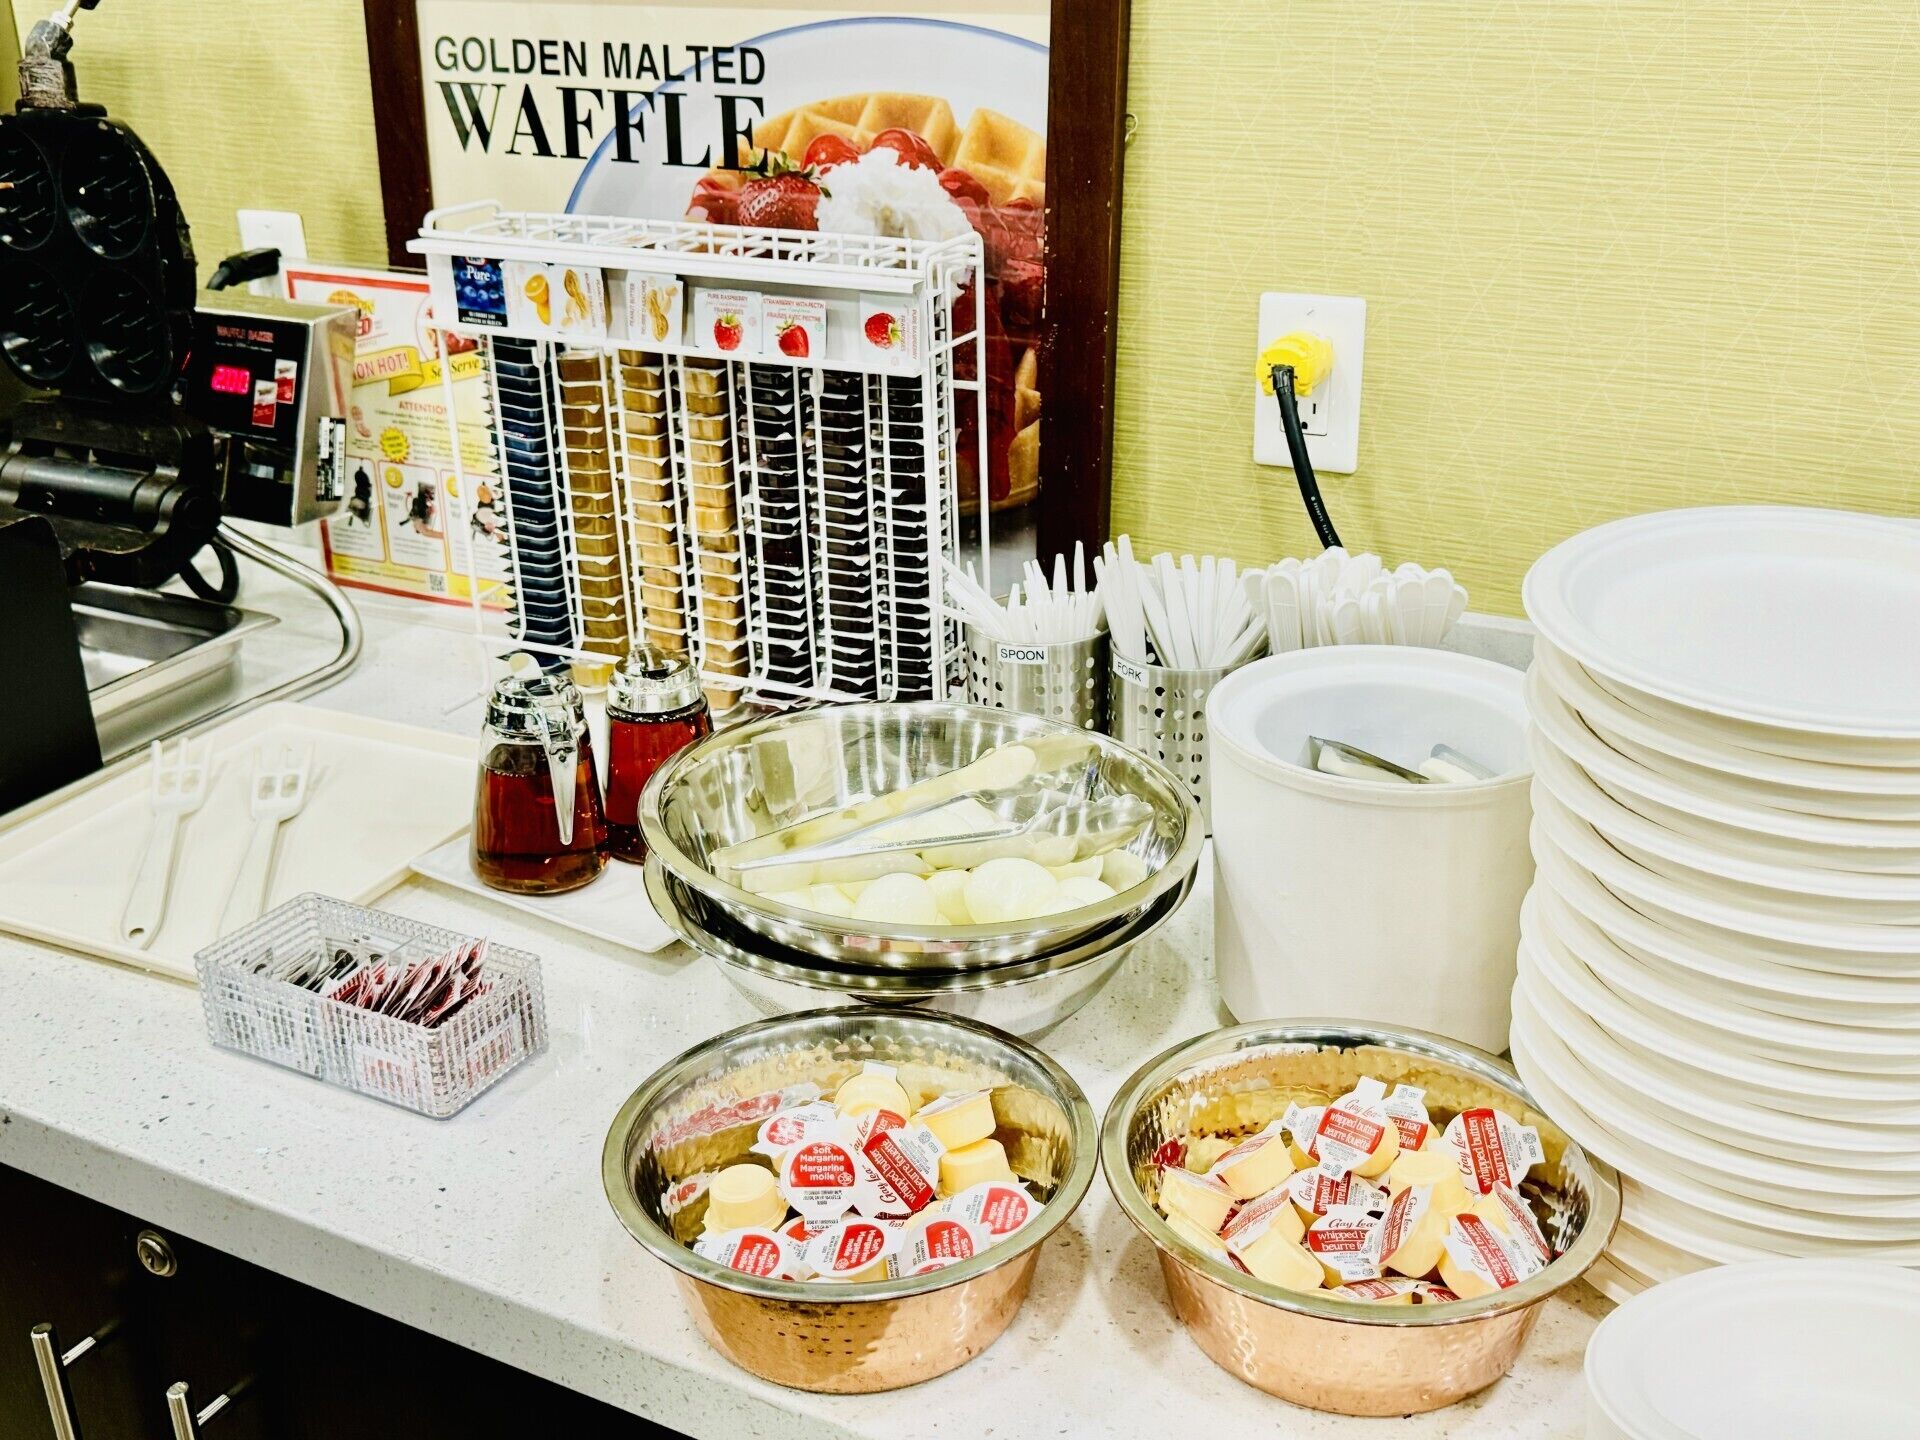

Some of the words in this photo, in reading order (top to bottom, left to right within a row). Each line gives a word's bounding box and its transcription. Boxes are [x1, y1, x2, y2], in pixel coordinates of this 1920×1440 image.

[434, 36, 588, 77] GOLDEN
[603, 42, 766, 85] MALTED
[434, 80, 769, 172] WAFFLE
[466, 264, 490, 282] Pure
[378, 352, 409, 373] HOT!
[451, 358, 480, 375] Serve
[399, 400, 447, 416] ATTENTIO
[1000, 648, 1045, 661] SPOON
[1117, 661, 1142, 682] FORK
[1330, 1111, 1357, 1130] whipped
[1356, 1120, 1379, 1137] butter
[1468, 1116, 1483, 1151] butter
[813, 1146, 832, 1154] Soft
[1451, 1130, 1467, 1150] Lea
[800, 1154, 845, 1163] Margarine
[869, 1148, 892, 1172] butter
[880, 1138, 907, 1168] fouetté
[1457, 1151, 1473, 1176] Gay
[800, 1164, 845, 1173] Margarine
[865, 1165, 881, 1183] Lea
[1475, 1145, 1493, 1186] whipped
[887, 1171, 917, 1204] whipped
[900, 1164, 928, 1194] beurre
[877, 1181, 898, 1204] Gay
[994, 1195, 1008, 1230] Margarine
[1004, 1196, 1020, 1230] Margarine
[1016, 1206, 1026, 1222] Soft
[1329, 1219, 1355, 1229] Gay
[1356, 1219, 1373, 1228] Lea
[851, 1230, 867, 1264] Margarine
[860, 1229, 877, 1263] Margarine
[871, 1237, 882, 1253] Soft
[1317, 1231, 1358, 1241] whipped
[1321, 1242, 1356, 1251] beurre
[1480, 1246, 1506, 1284] whipped
